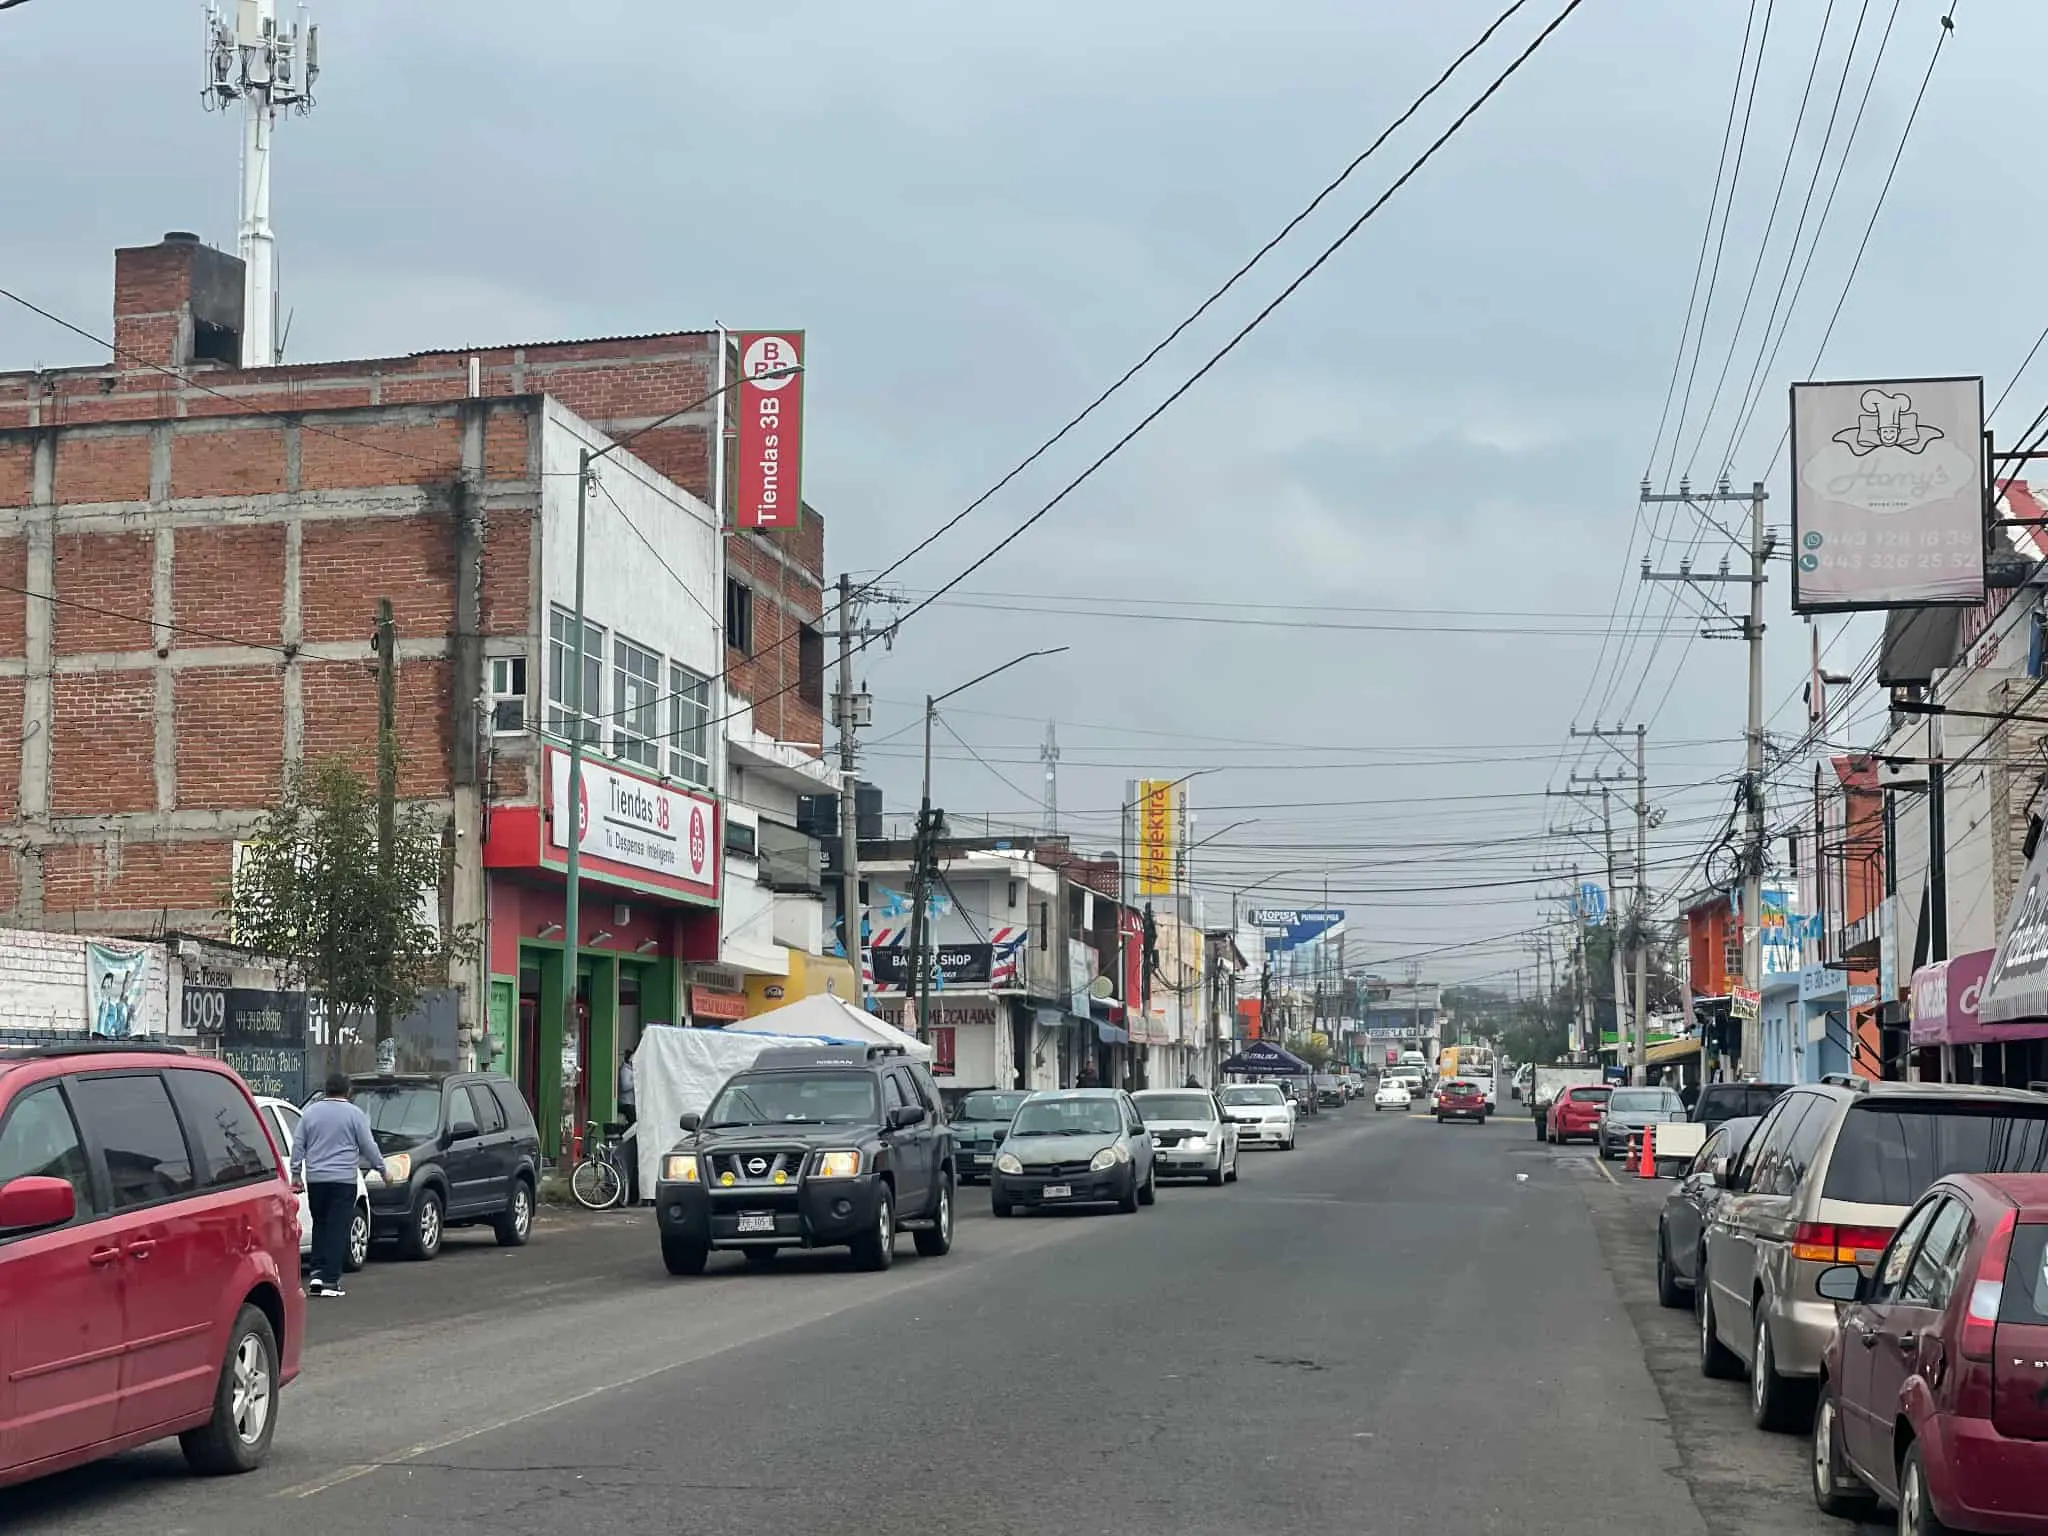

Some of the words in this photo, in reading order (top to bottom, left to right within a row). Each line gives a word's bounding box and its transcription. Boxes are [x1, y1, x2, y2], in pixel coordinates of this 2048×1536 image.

[764, 343, 779, 360] B
[760, 397, 779, 428] 3B
[758, 434, 779, 524] Tiendas
[609, 777, 653, 822] Tiendas
[656, 795, 670, 831] 3B
[605, 828, 613, 847] Tu
[940, 954, 971, 965] SHOP
[186, 991, 225, 1028] 1909
